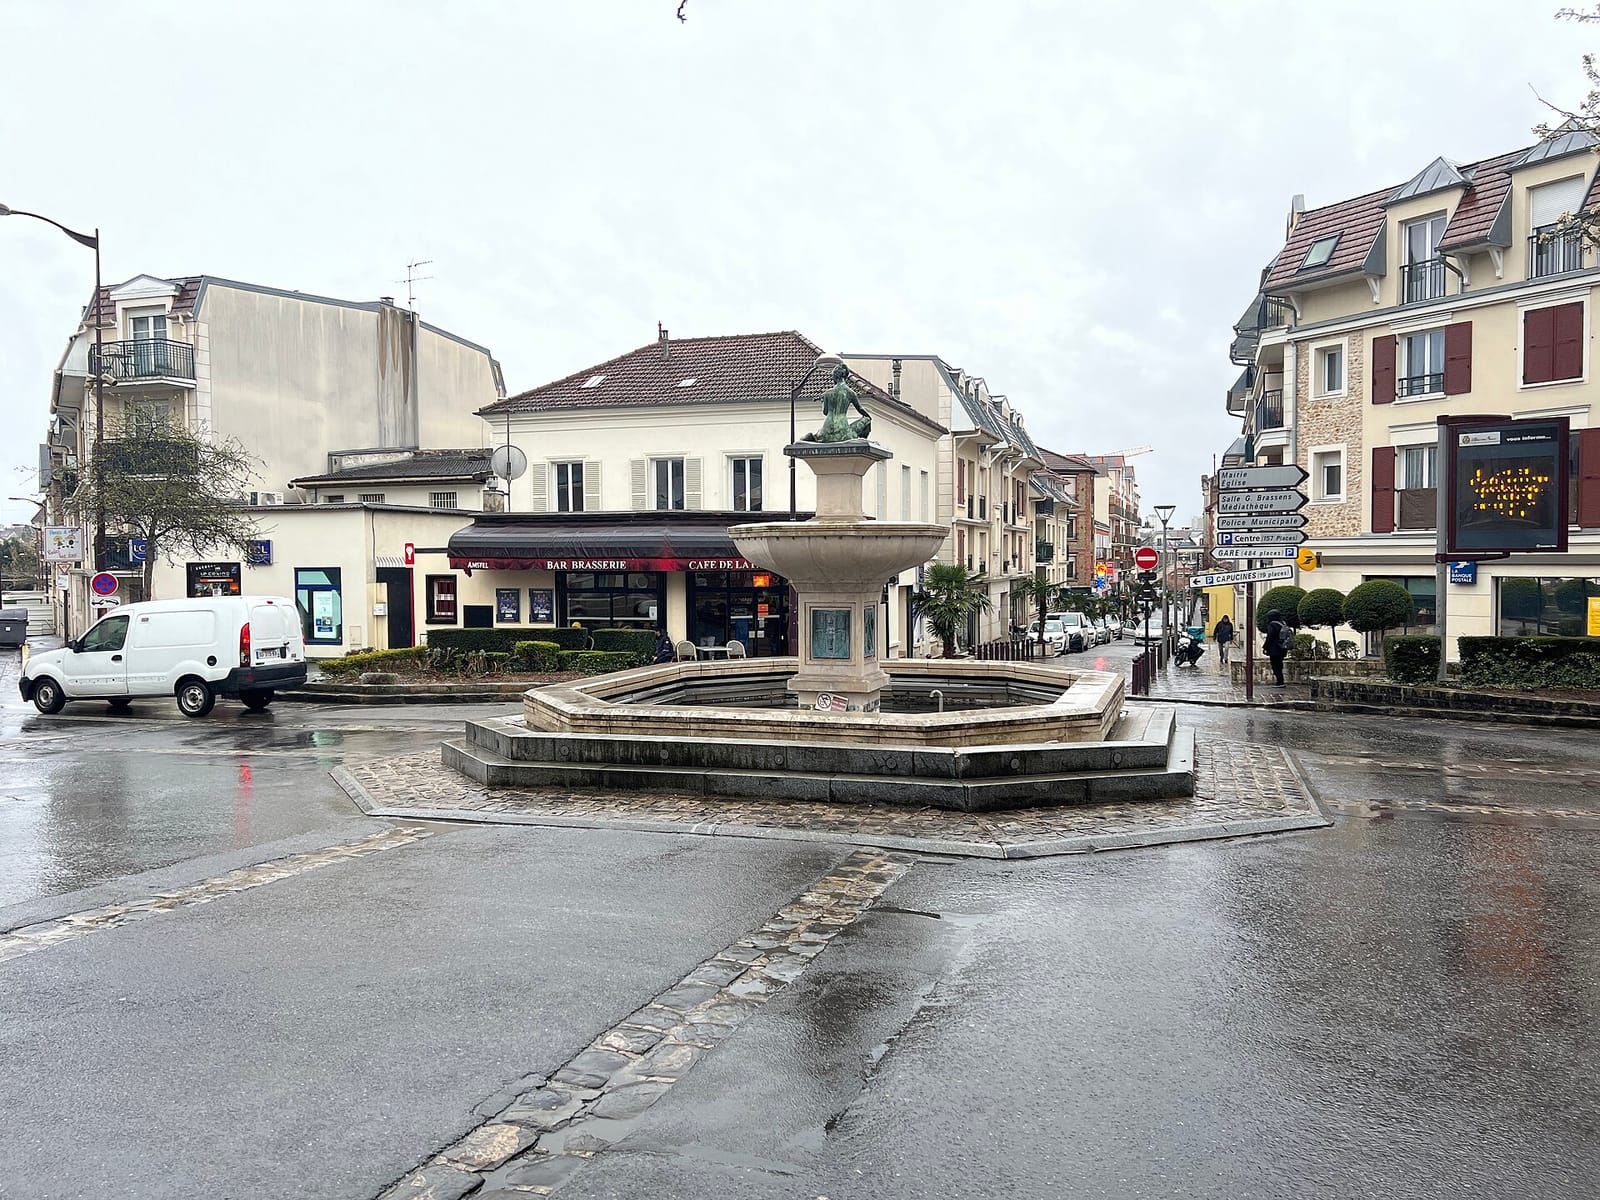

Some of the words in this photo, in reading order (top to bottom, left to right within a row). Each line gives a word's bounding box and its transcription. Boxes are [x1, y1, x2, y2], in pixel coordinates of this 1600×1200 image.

[1221, 471, 1248, 479] Mairie
[1221, 479, 1247, 487] Église
[1245, 494, 1253, 502] G.
[1221, 503, 1274, 511] Médiathèque
[1250, 517, 1298, 526] Municipale
[1218, 549, 1240, 557] GARE
[547, 561, 568, 570] BAR
[571, 560, 627, 570] BRASSERIE
[689, 560, 717, 570] CAFE
[719, 560, 734, 569] DE
[735, 560, 749, 569] LA
[1216, 571, 1257, 583] CAPUCINES
[1267, 569, 1290, 578] places)
